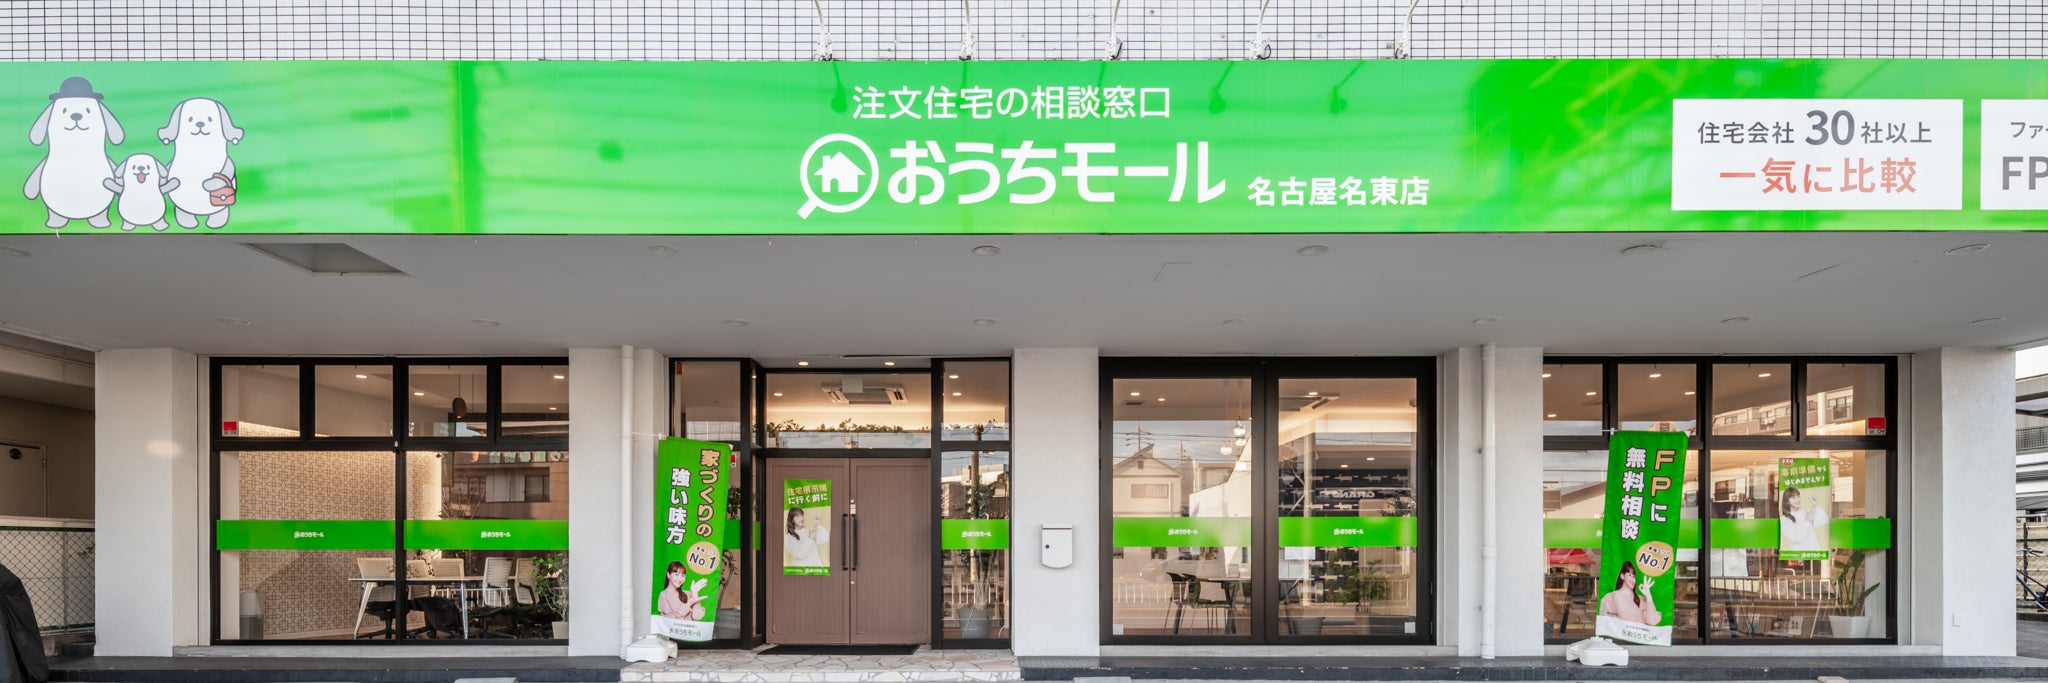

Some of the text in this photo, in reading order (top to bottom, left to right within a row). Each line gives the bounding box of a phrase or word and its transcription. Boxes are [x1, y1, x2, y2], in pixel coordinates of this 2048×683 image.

[852, 85, 1171, 119] 注文住宅の相談窓口
[1697, 110, 1933, 146] 住宅会社 30 社以上
[2010, 121, 2048, 139] ファ
[887, 140, 1430, 206] おうちモール 名古屋名東店
[1719, 156, 1917, 194] 一気に比較
[2002, 156, 2048, 191] FP
[696, 448, 721, 538] 家づくりの
[788, 484, 828, 496] 住宅展示場
[788, 494, 829, 505] に行く前に
[1621, 447, 1646, 540] 無料相談
[1650, 449, 1677, 522] FPに
[666, 467, 691, 545] 強い味方
[689, 552, 717, 570] No.1
[1638, 552, 1670, 570] No.1
